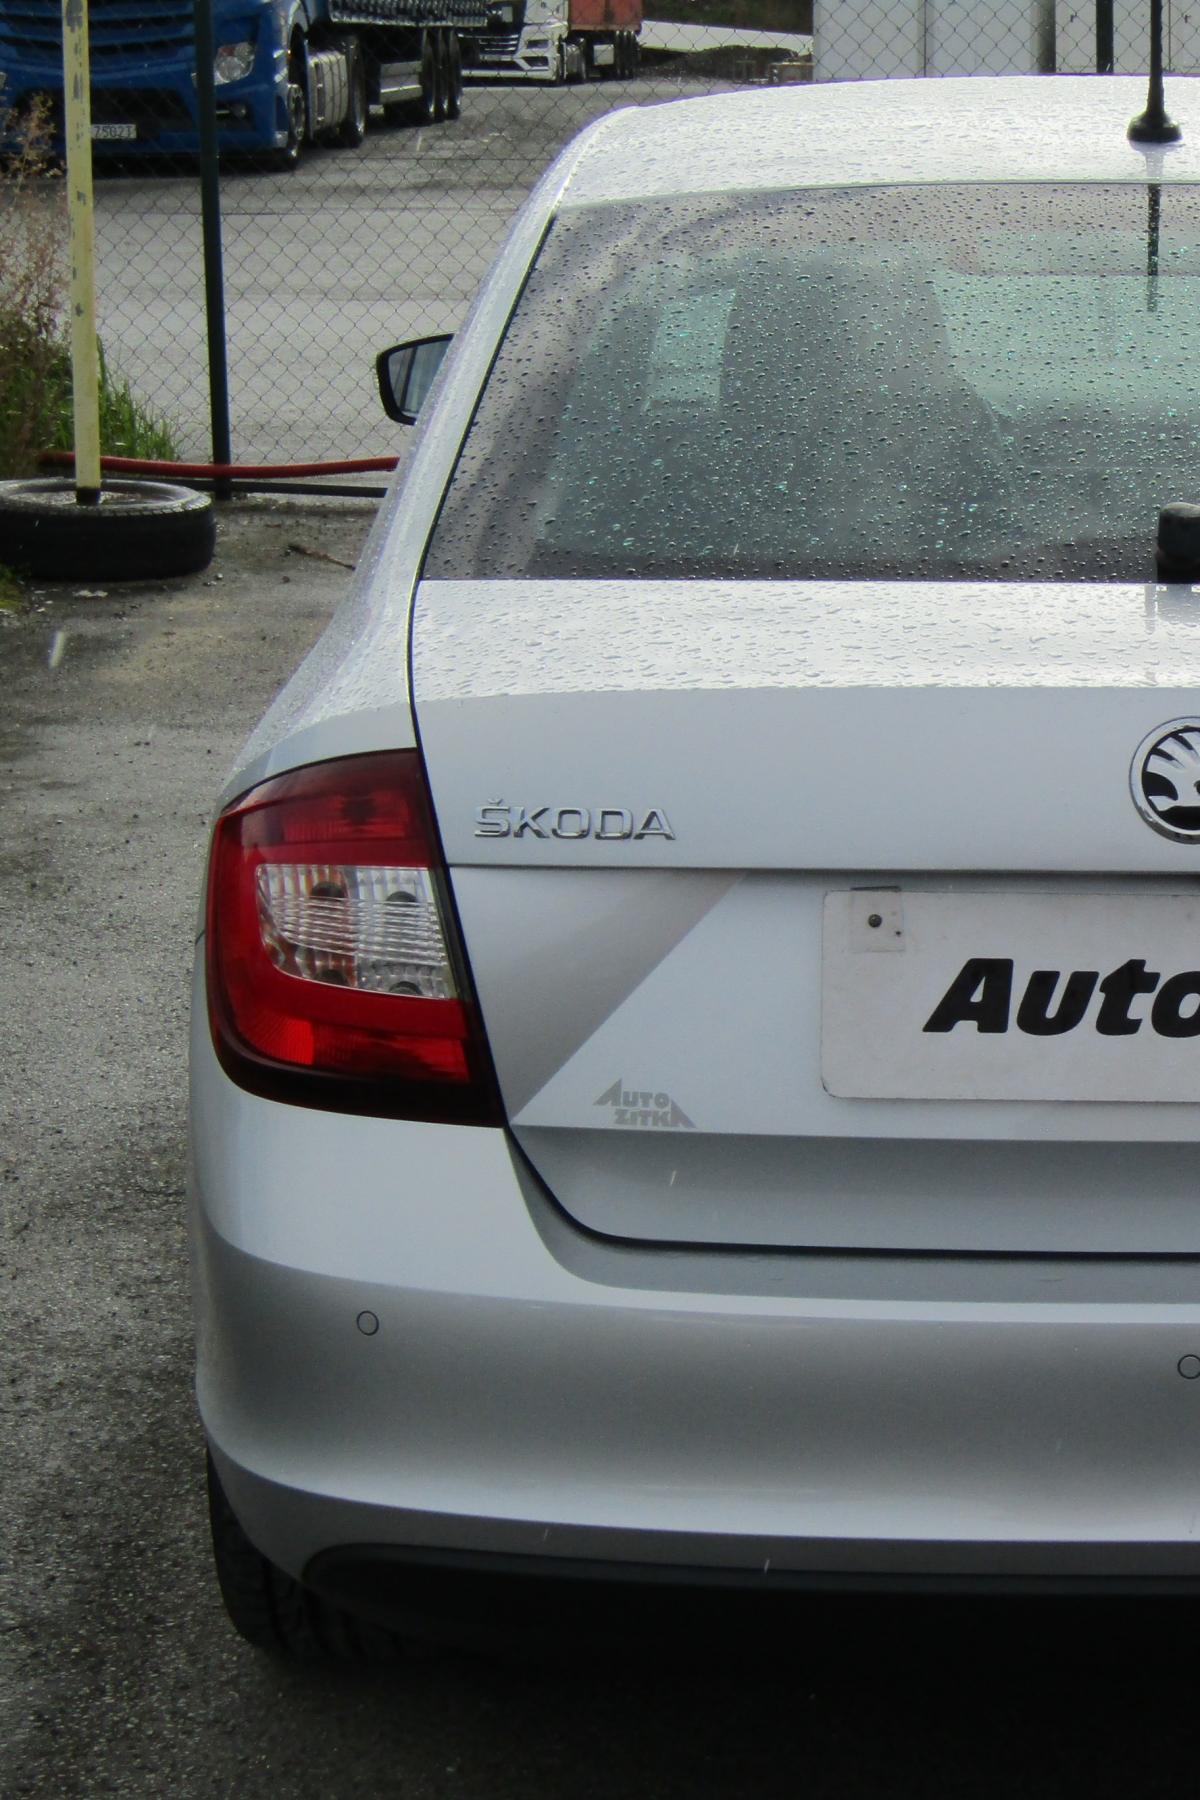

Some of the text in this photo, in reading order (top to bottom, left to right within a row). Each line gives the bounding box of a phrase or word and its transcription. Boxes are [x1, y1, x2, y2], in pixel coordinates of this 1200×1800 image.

[474, 798, 676, 840] ŠKODA
[592, 1078, 670, 1109] AUTO
[614, 1099, 697, 1129] ZITKA
